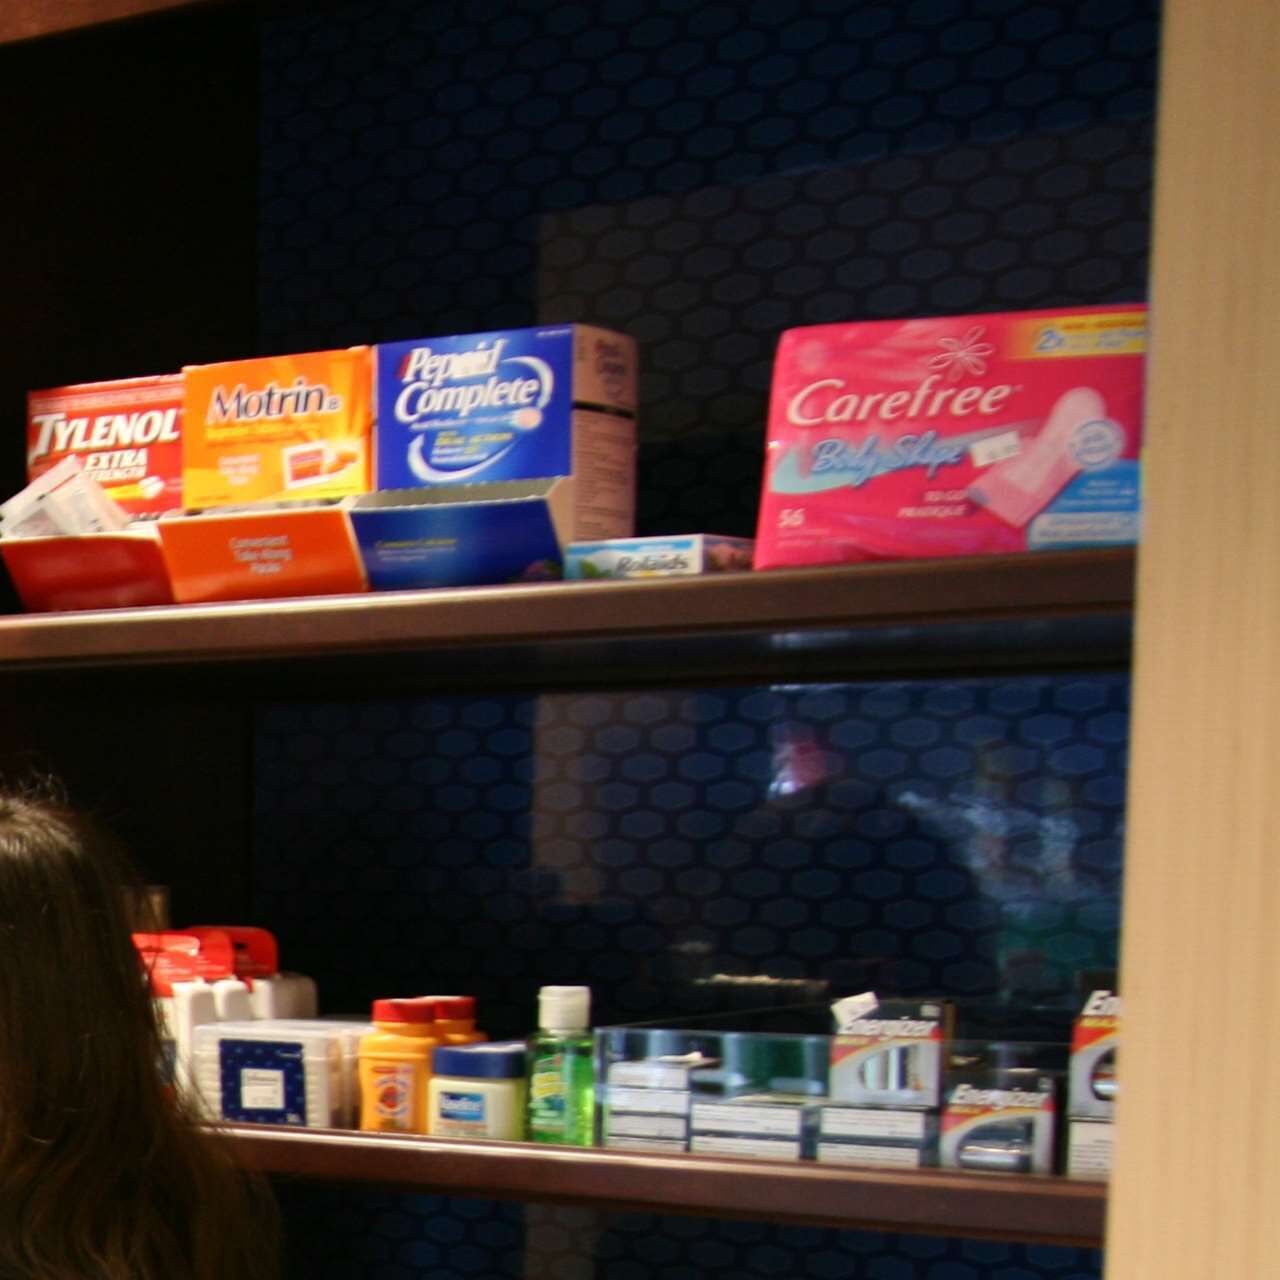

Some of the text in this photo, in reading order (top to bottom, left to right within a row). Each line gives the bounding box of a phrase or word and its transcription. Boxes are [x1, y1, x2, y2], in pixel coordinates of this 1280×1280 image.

[403, 340, 506, 388] Pepd
[206, 377, 326, 424] Motrin
[394, 376, 540, 424] Complete
[787, 374, 1011, 426] Carefree
[28, 409, 181, 466] TYLENOL
[84, 448, 148, 471] EXTRA
[1081, 989, 1120, 1016] En
